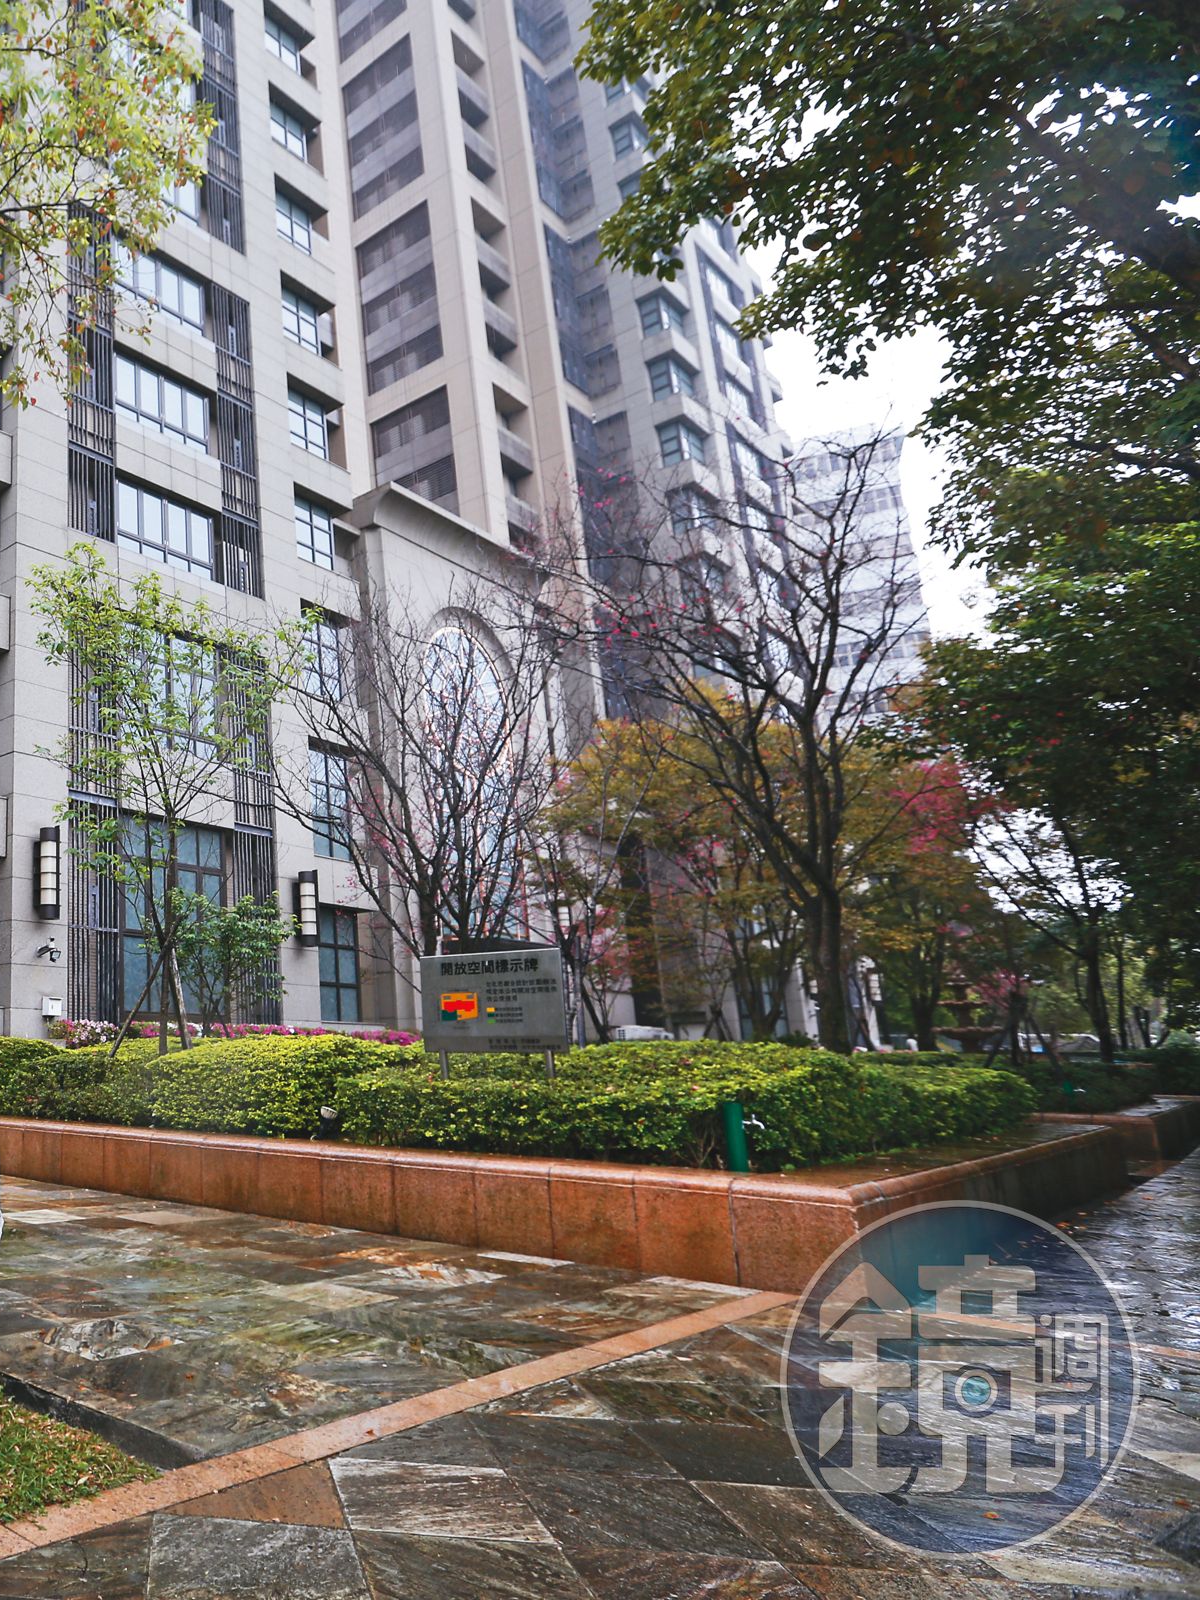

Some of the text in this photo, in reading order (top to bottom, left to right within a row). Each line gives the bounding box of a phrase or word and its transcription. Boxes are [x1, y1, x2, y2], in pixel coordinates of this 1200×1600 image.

[441, 958, 538, 976] 開放空間標示牌
